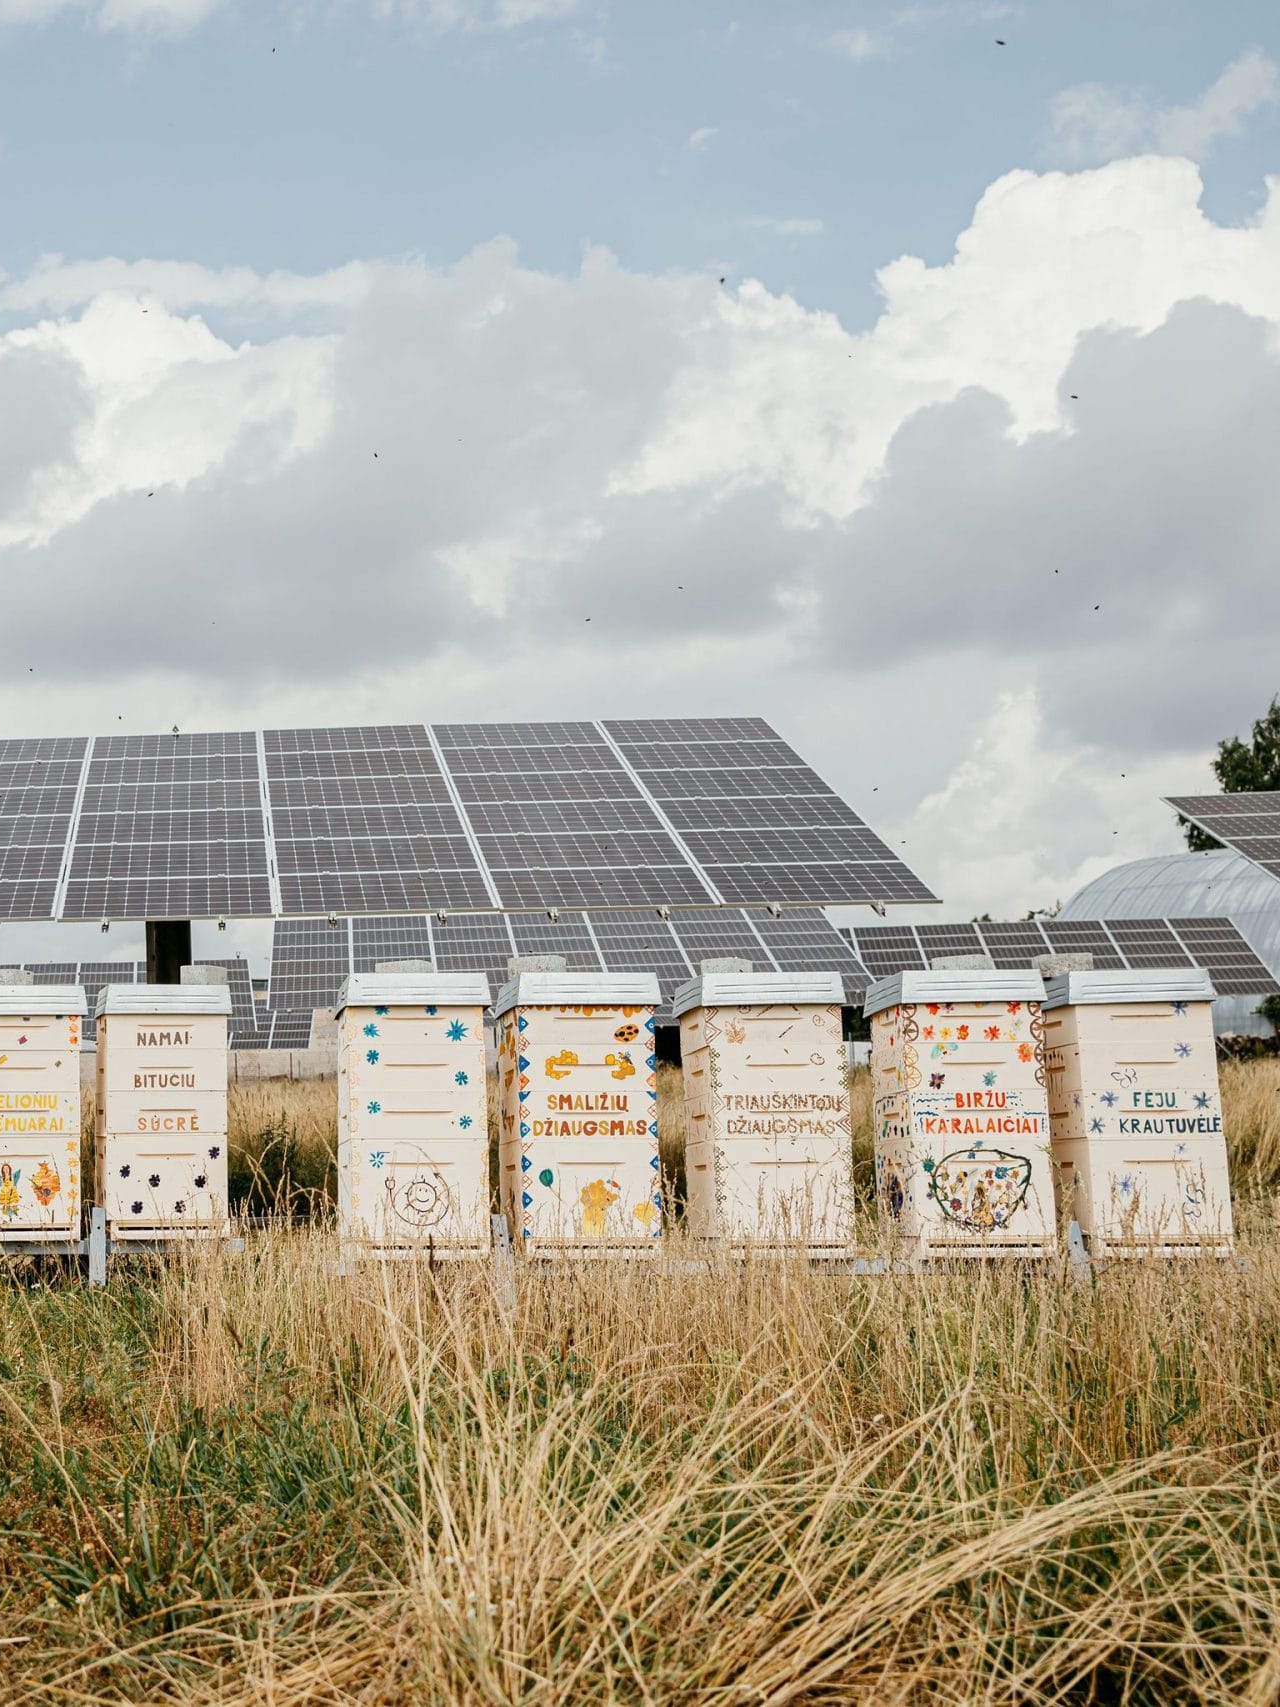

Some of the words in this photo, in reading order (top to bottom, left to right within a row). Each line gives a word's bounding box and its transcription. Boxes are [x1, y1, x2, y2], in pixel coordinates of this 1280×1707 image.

[136, 1031, 189, 1047] NAMAI
[532, 1117, 648, 1137] DŽIAUGSMAS
[727, 1115, 836, 1135] DŽIAUGSMAS
[925, 1116, 1039, 1135] KARALAIČIAI
